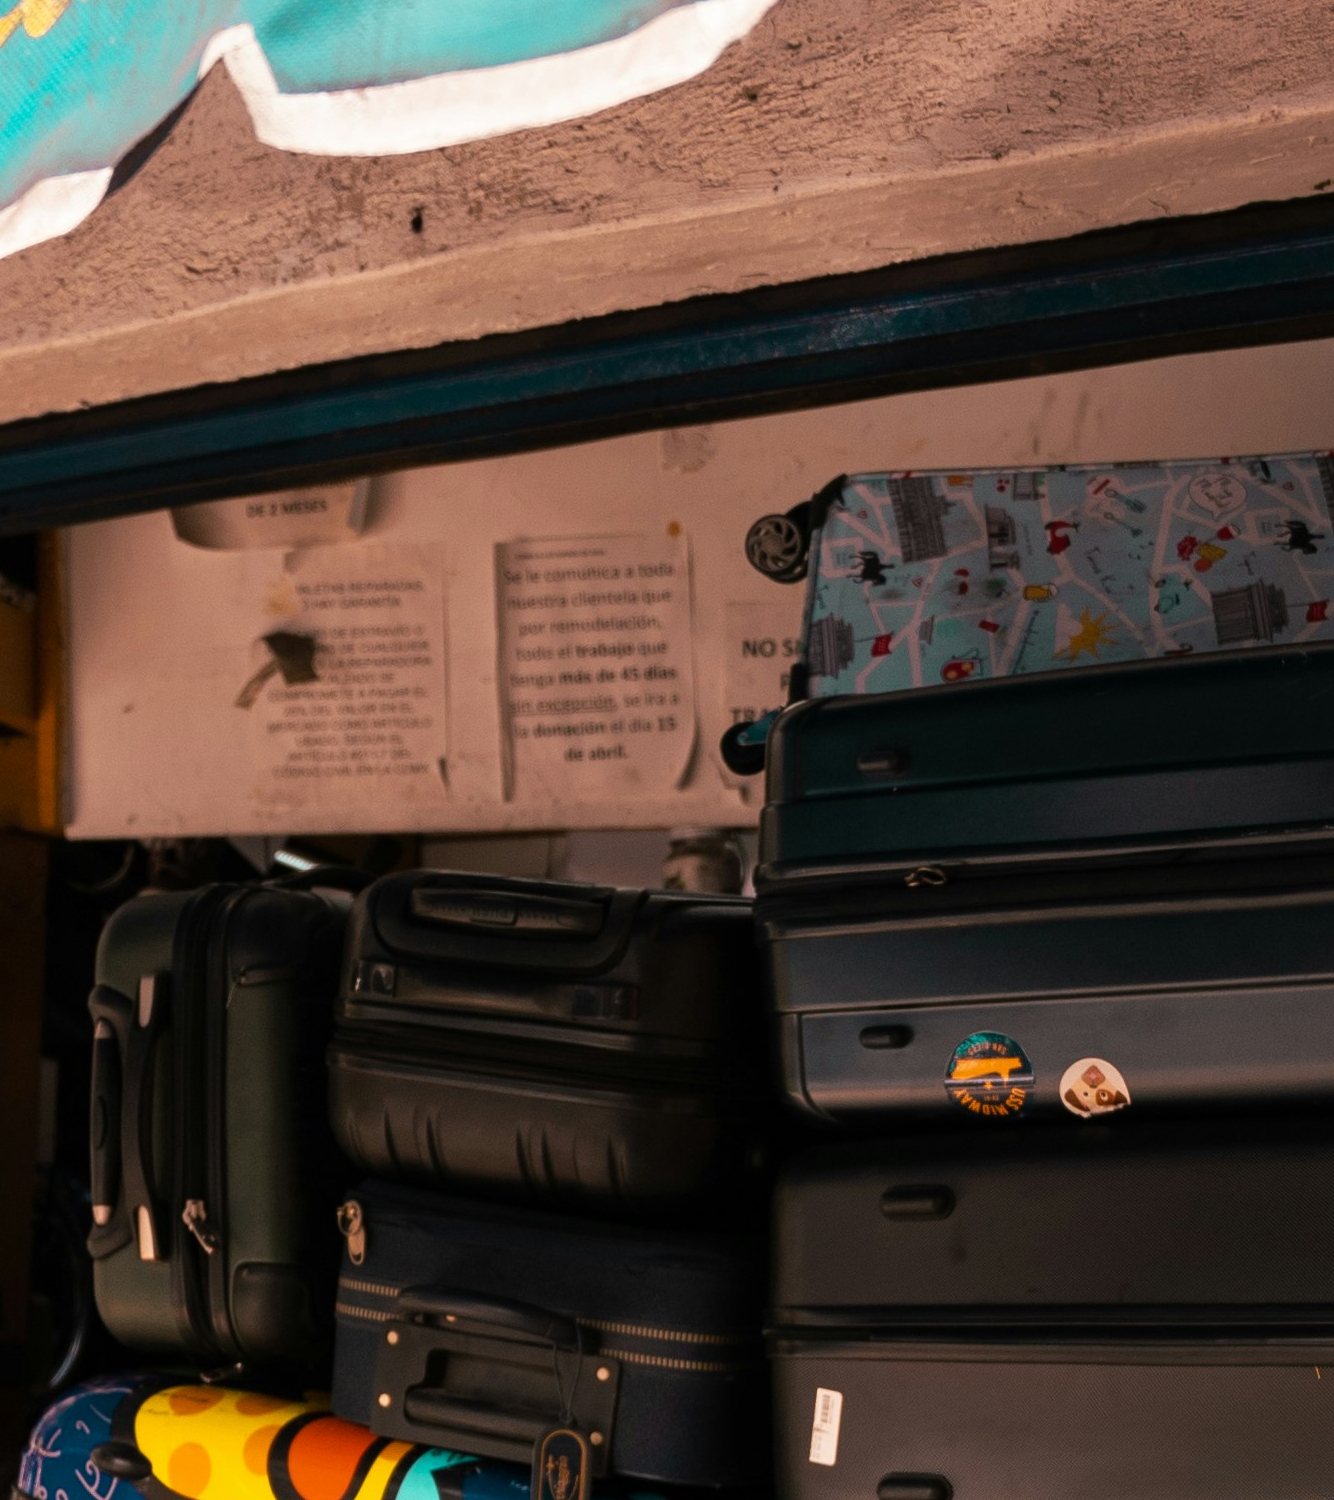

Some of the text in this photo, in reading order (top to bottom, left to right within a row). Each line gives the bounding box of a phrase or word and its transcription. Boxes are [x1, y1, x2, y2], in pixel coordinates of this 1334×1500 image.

[543, 566, 621, 583] comunica
[507, 589, 673, 610] nuestra clientela que
[518, 621, 546, 637] por
[516, 647, 554, 661] todo
[574, 641, 634, 660] trabajo
[636, 640, 668, 657] que
[741, 639, 776, 658] NO
[509, 671, 554, 689] tenga
[596, 668, 616, 683] de
[619, 667, 640, 681] 45
[532, 719, 606, 738] donación
[563, 747, 584, 761] de
